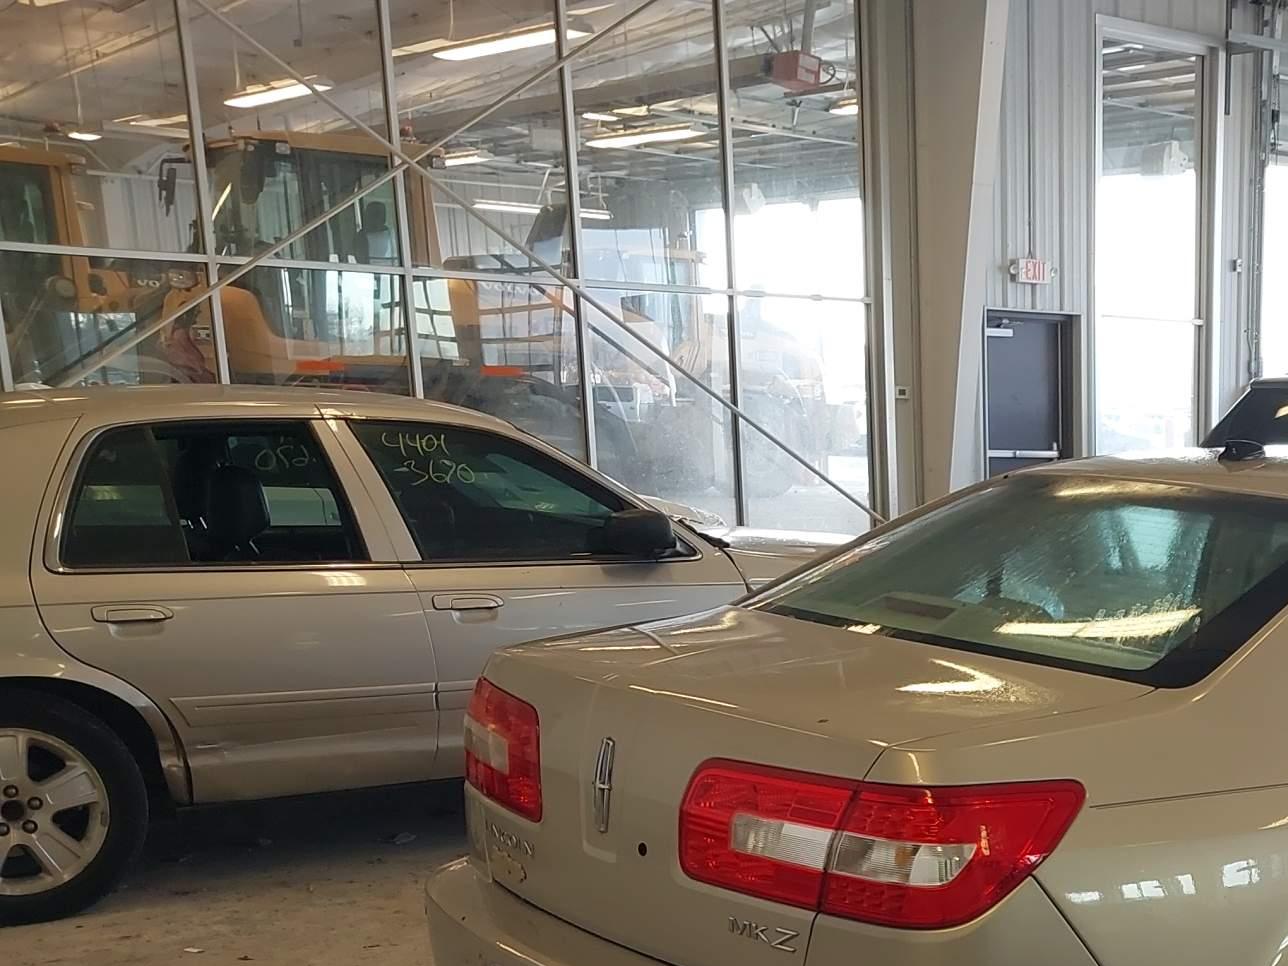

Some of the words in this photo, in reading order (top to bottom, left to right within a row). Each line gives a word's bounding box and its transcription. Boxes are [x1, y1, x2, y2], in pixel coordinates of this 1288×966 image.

[1024, 260, 1047, 281] EXIT
[381, 432, 450, 456] 4401
[727, 916, 800, 953] MKZ
